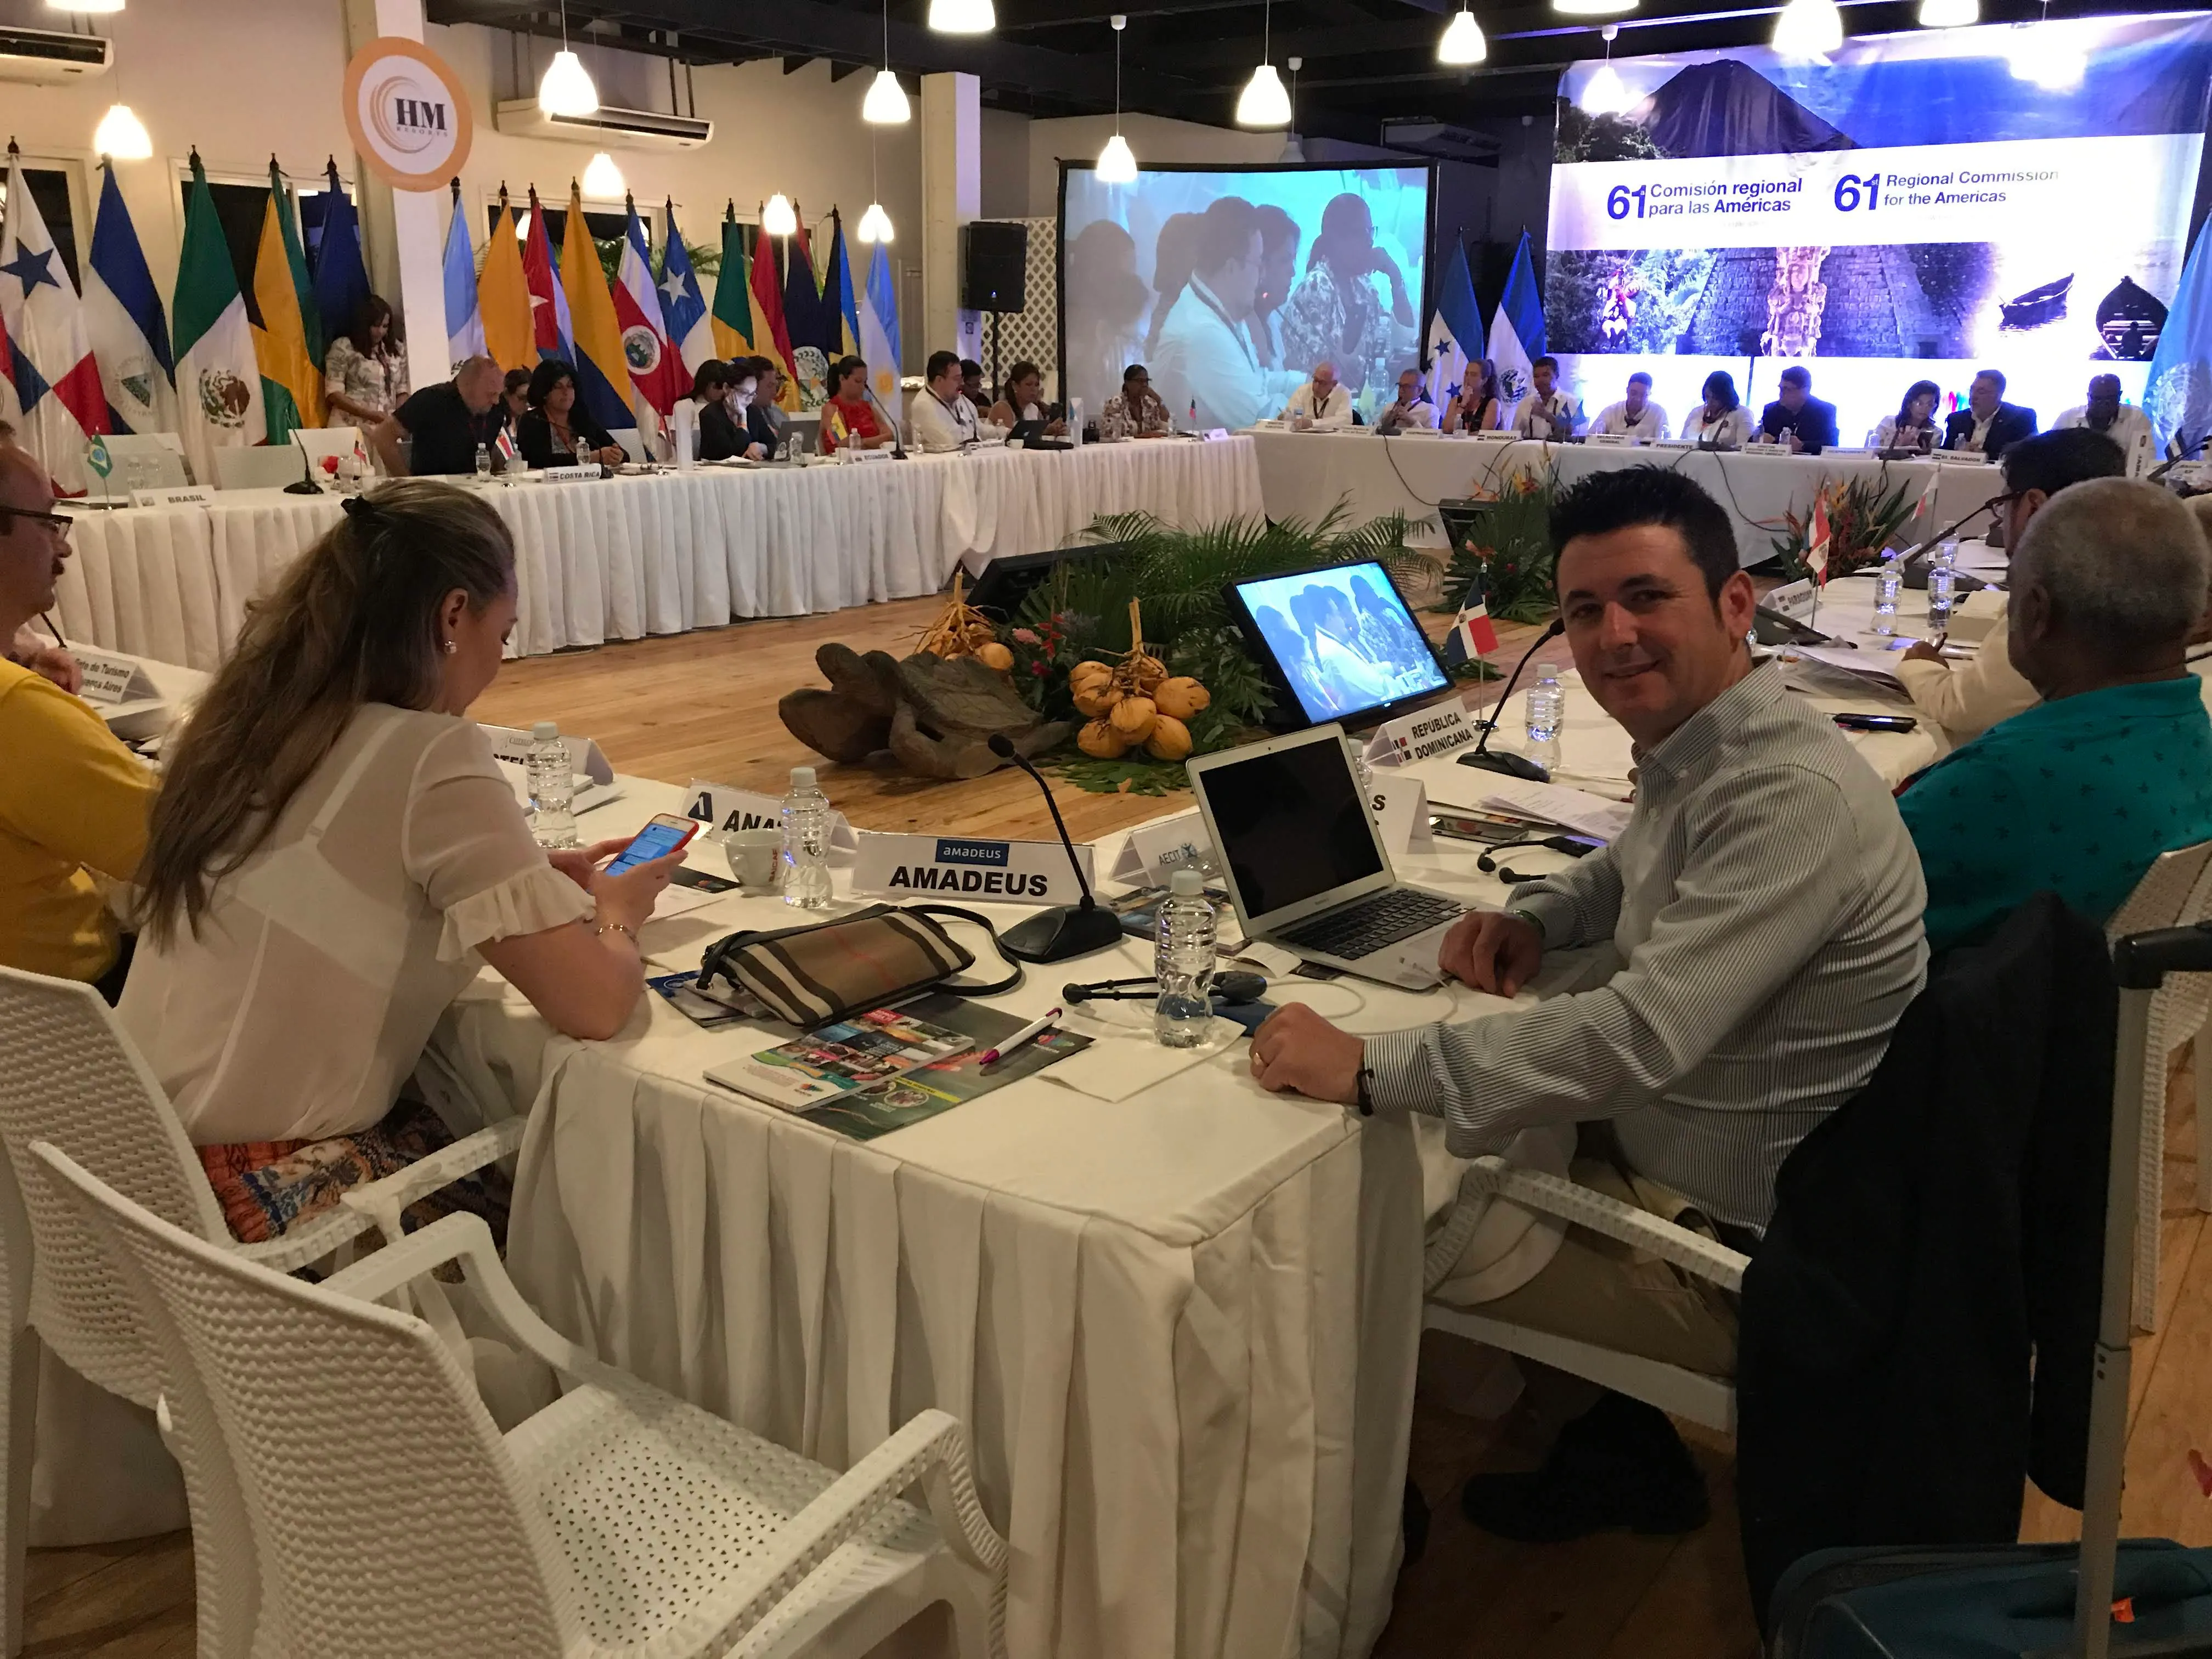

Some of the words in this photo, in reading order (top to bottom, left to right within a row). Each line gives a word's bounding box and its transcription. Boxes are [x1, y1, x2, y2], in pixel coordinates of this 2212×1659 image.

[395, 98, 447, 130] HM
[397, 127, 448, 137] RESORTS
[1650, 180, 1727, 198] Comisión
[1733, 177, 1803, 198] regional
[1886, 172, 1954, 189] Regional
[1959, 171, 2058, 184] Commission
[1607, 185, 1646, 219] 61
[1834, 173, 1881, 212] 61
[1884, 194, 1904, 206] for
[1908, 192, 1931, 205] the
[1934, 190, 2006, 205] Americas
[1649, 204, 1683, 218] para
[1688, 201, 1710, 214] las
[1714, 196, 1791, 213] Américas
[167, 494, 206, 504] BRASIL
[101, 664, 129, 678] Turismo
[103, 681, 122, 693] Aires
[1412, 712, 1462, 740] REPÚBLICA
[1414, 728, 1474, 760] DOMINICANA
[722, 809, 781, 832] ANA
[1158, 849, 1181, 866] AECIT
[889, 865, 1048, 897] AMADEUS
